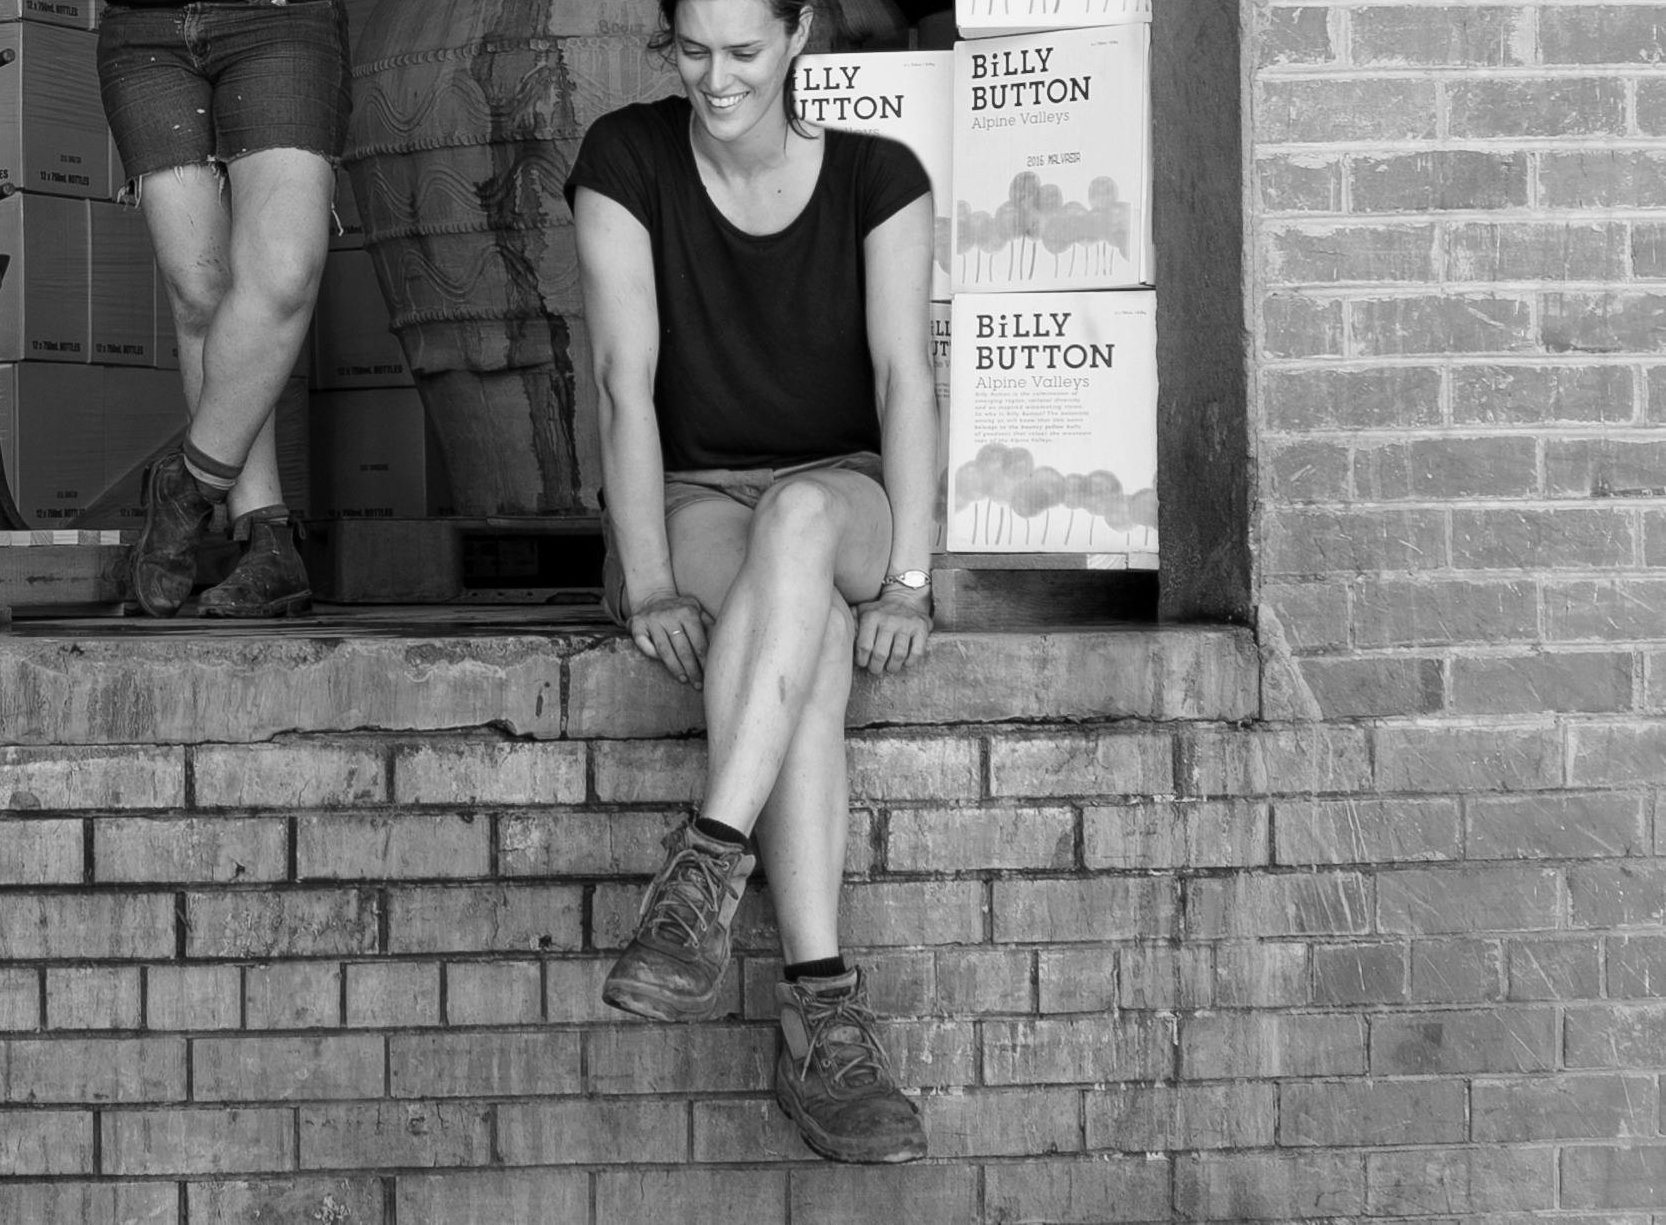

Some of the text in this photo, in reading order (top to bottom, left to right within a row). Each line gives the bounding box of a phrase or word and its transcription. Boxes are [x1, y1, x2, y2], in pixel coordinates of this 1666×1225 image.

[971, 76, 1092, 111] BUTTON
[971, 110, 1070, 131] Alpine Valleys
[975, 344, 1115, 370] BUTTON
[975, 375, 1090, 392] Alpine Valleys
